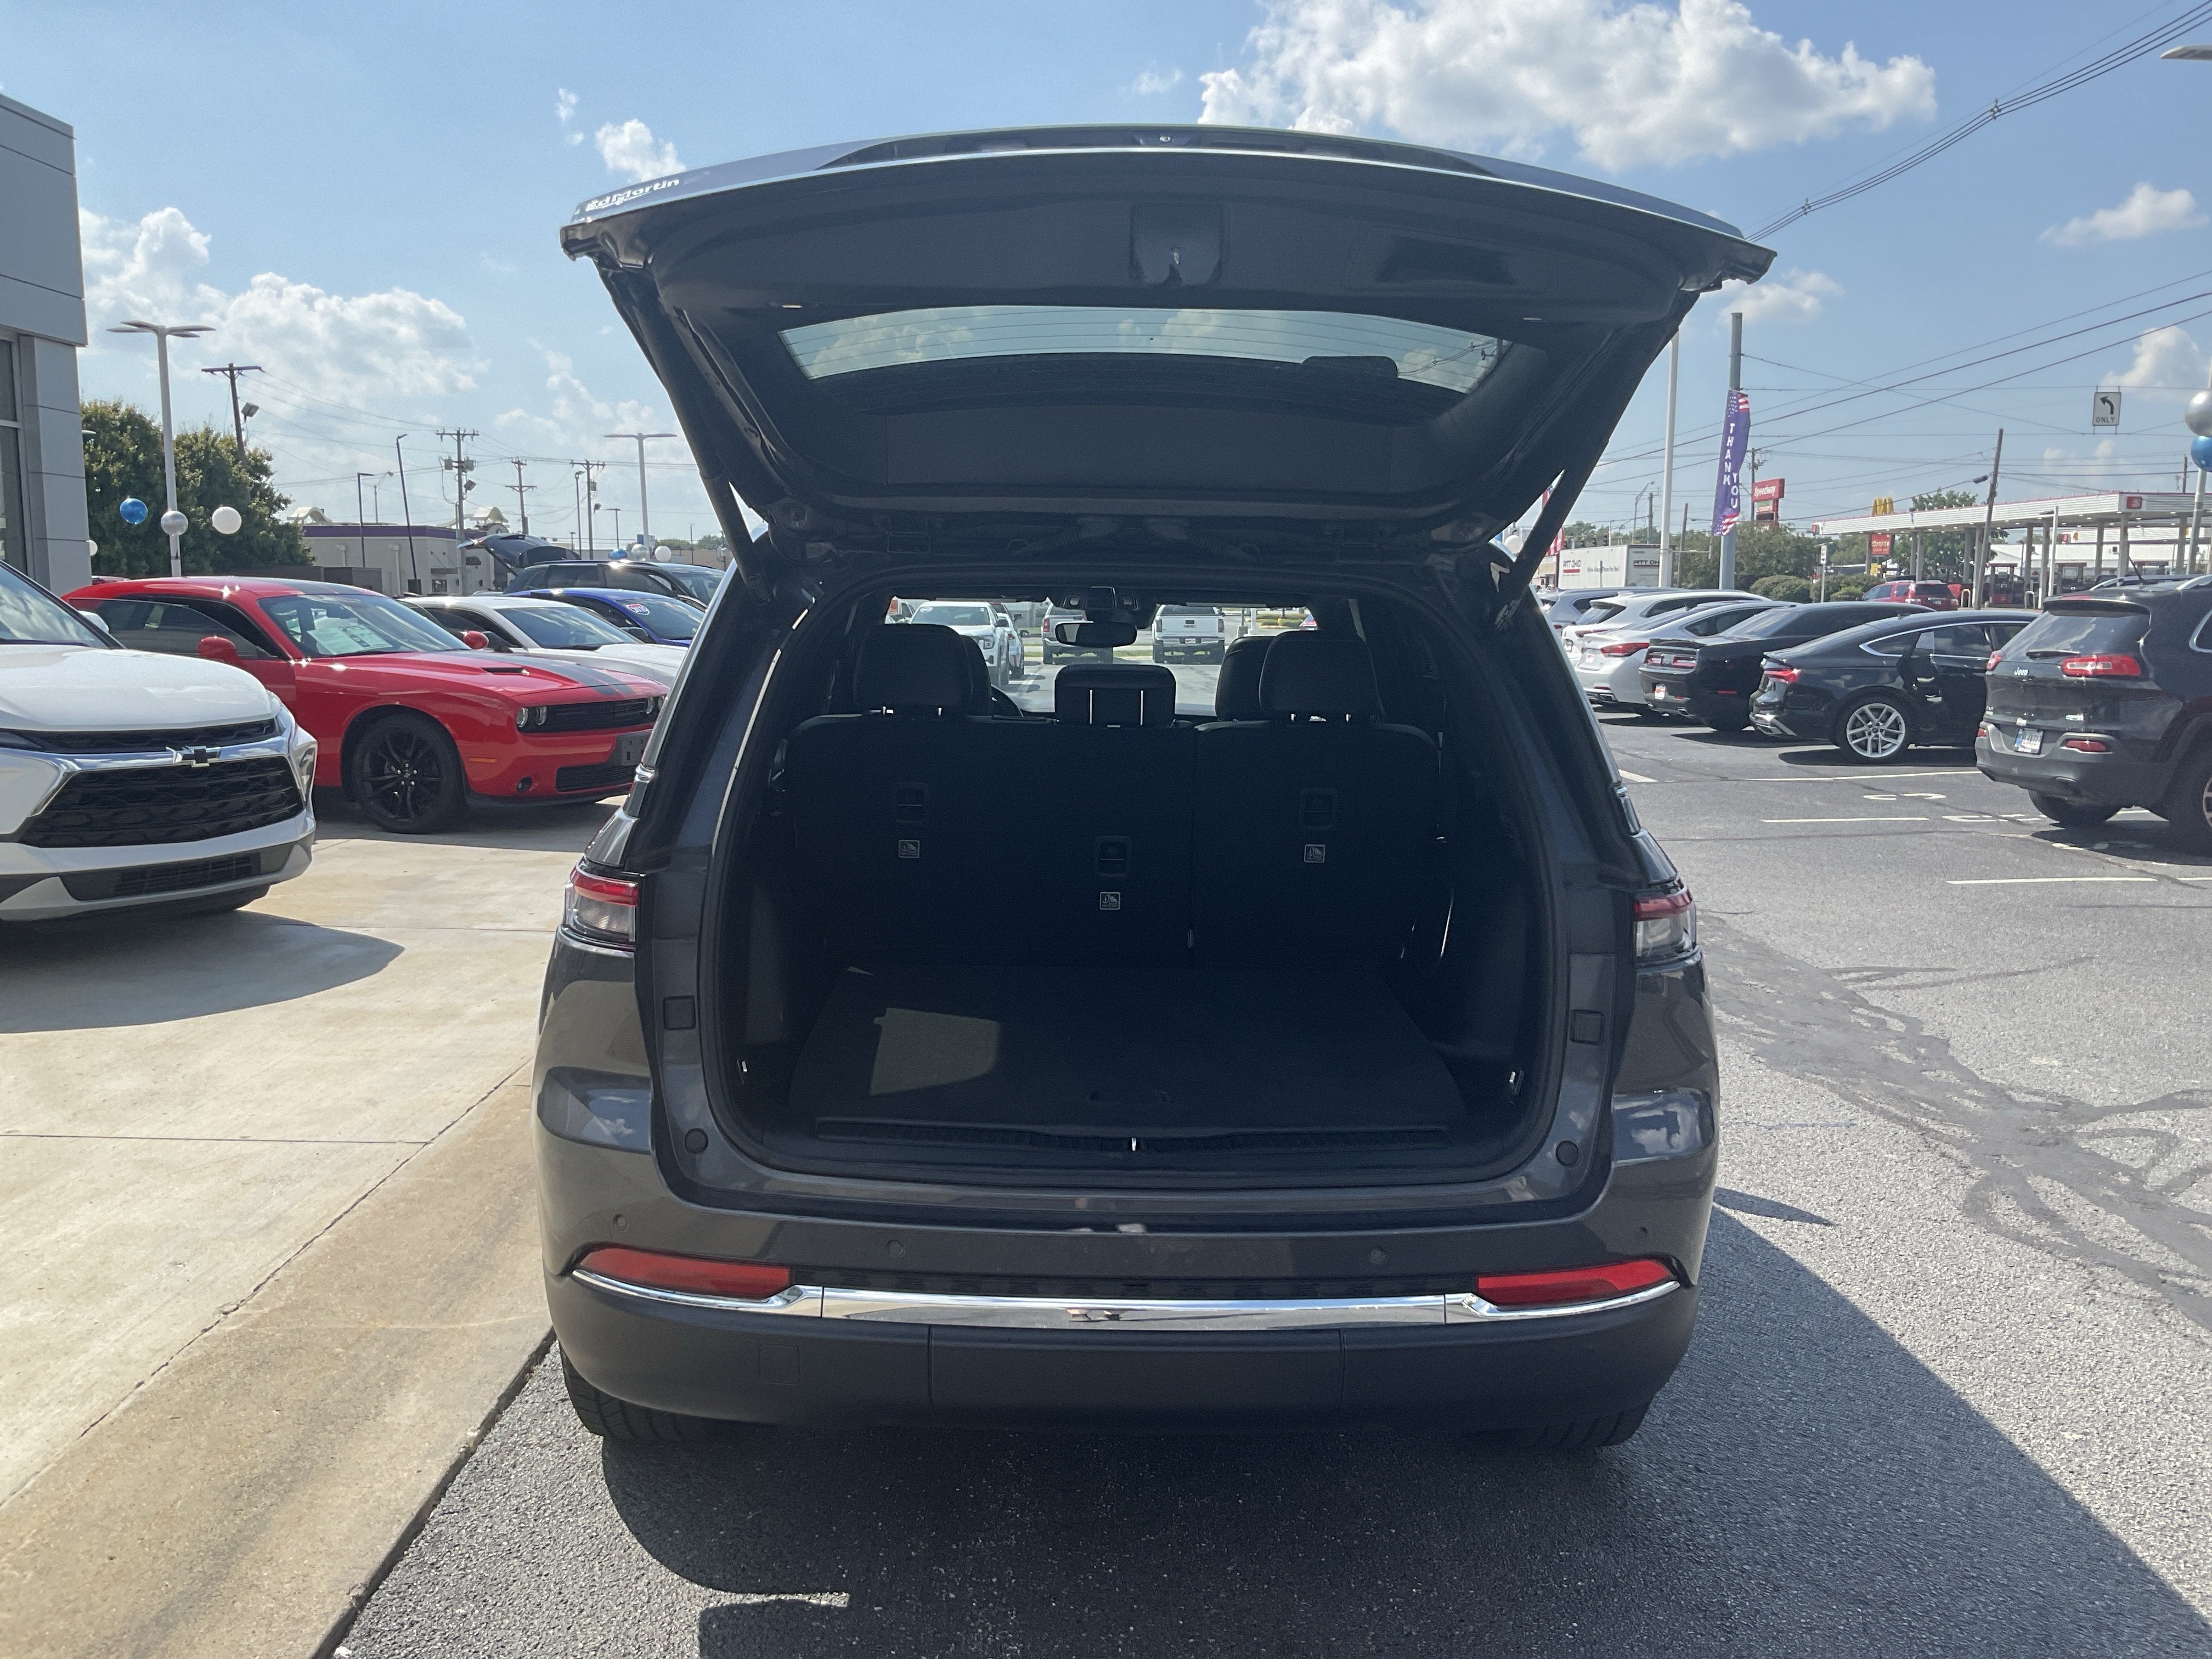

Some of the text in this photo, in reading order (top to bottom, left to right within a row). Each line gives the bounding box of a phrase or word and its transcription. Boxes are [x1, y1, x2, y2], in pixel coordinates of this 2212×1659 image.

[1723, 423, 1739, 509] THANK YOU
[1754, 485, 1776, 498] Speedway
[2014, 667, 2029, 676] Jeep
